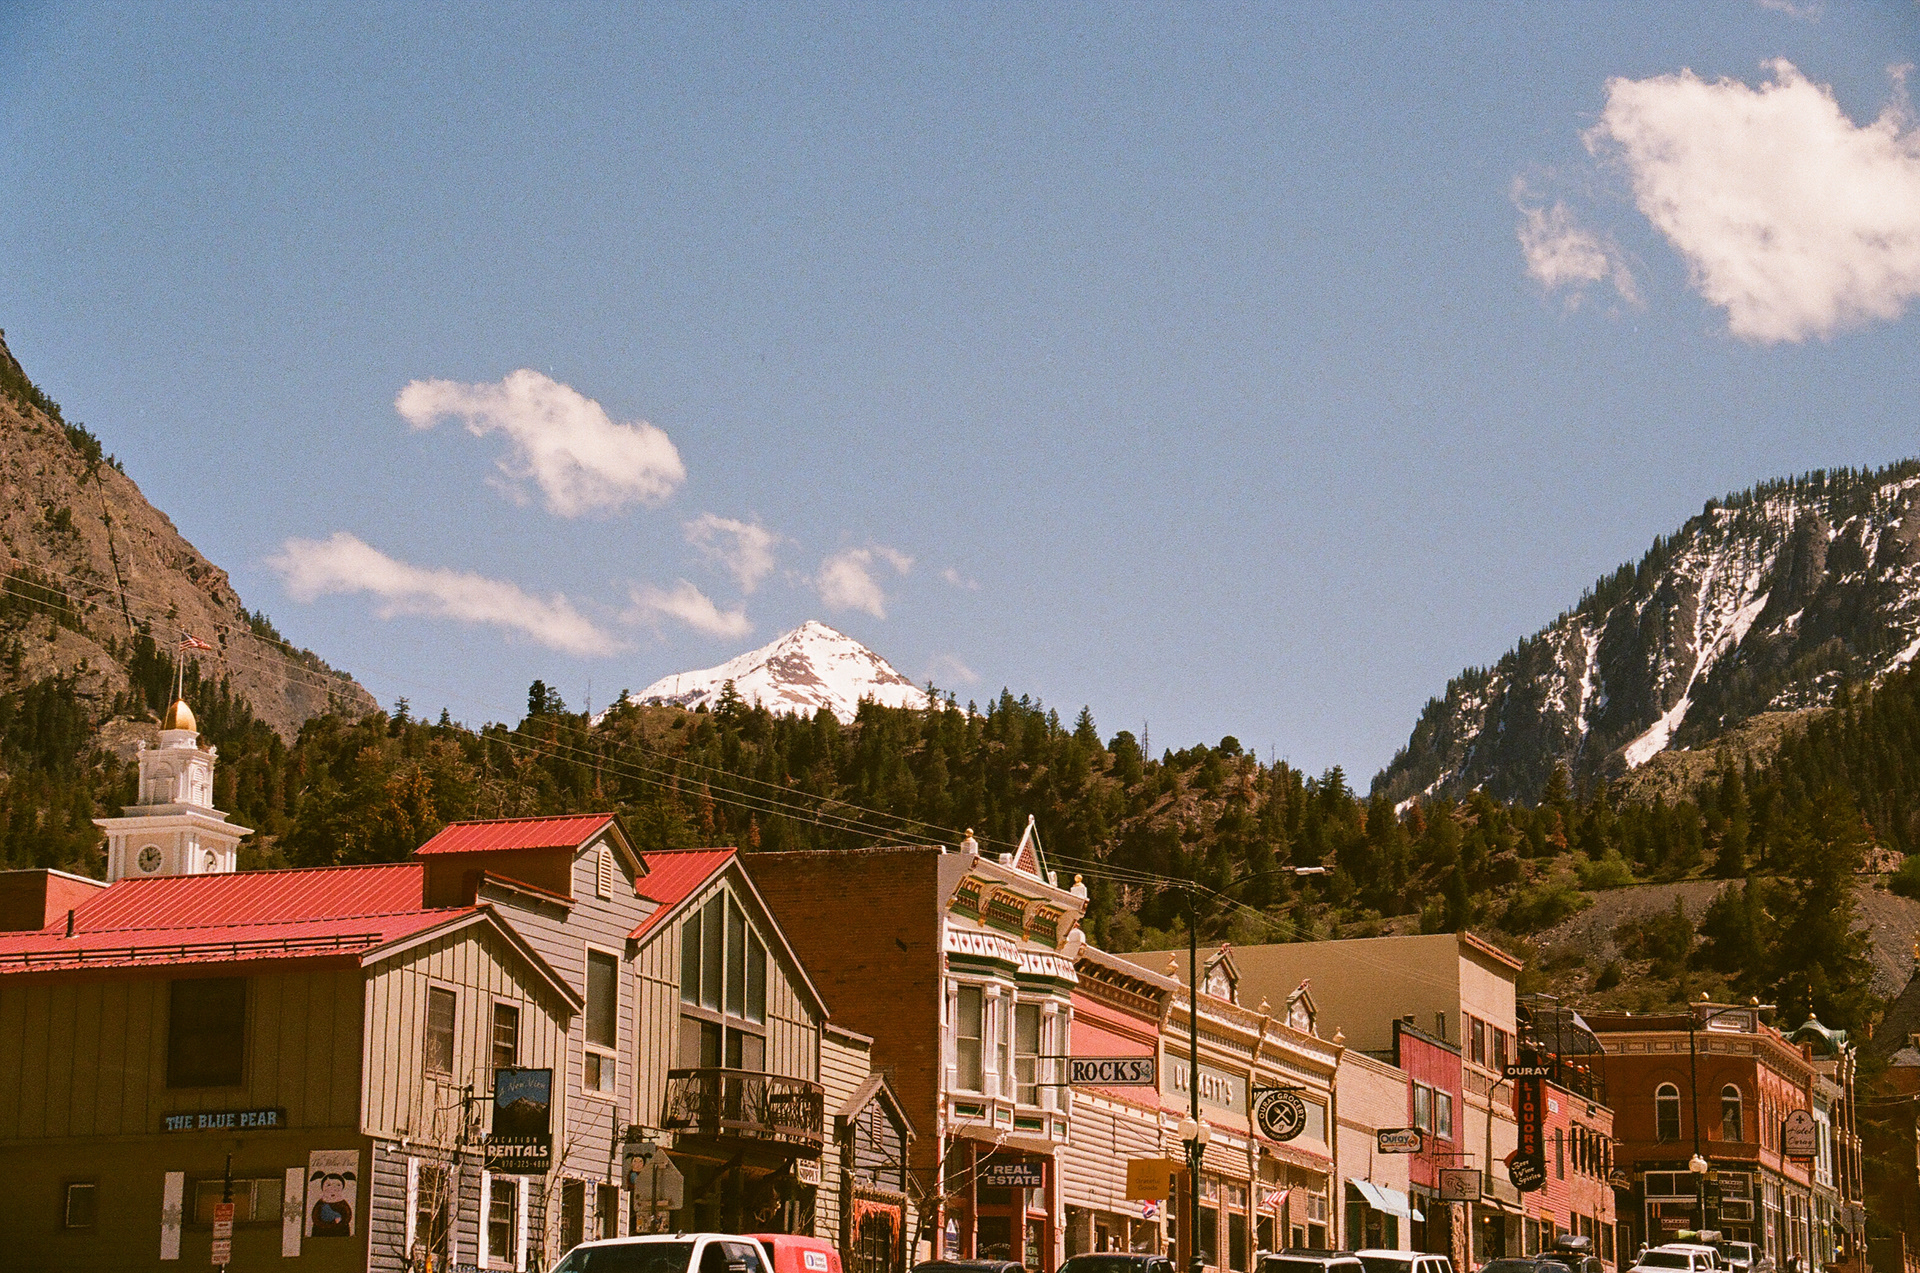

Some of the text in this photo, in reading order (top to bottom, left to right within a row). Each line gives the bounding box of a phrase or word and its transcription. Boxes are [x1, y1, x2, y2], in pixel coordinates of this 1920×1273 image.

[1072, 1061, 1142, 1081] ROCKS
[1507, 1067, 1550, 1075] OURAY
[1174, 1064, 1233, 1106] DUKETT'S
[1259, 1093, 1304, 1120] OURAY GROCERY
[166, 1111, 277, 1130] THE BLUE PEAR
[1523, 1082, 1535, 1155] LIQUORS
[1787, 1126, 1814, 1134] Hotel
[1380, 1134, 1410, 1144] Ouray
[1788, 1136, 1813, 1147] Ouray
[487, 1144, 548, 1157] RENTALS
[993, 1165, 1032, 1175] REAL
[1511, 1160, 1529, 1171] Beer
[1513, 1167, 1535, 1179] Wine
[987, 1175, 1041, 1185] ESTATE
[1517, 1173, 1542, 1186] Spirits
